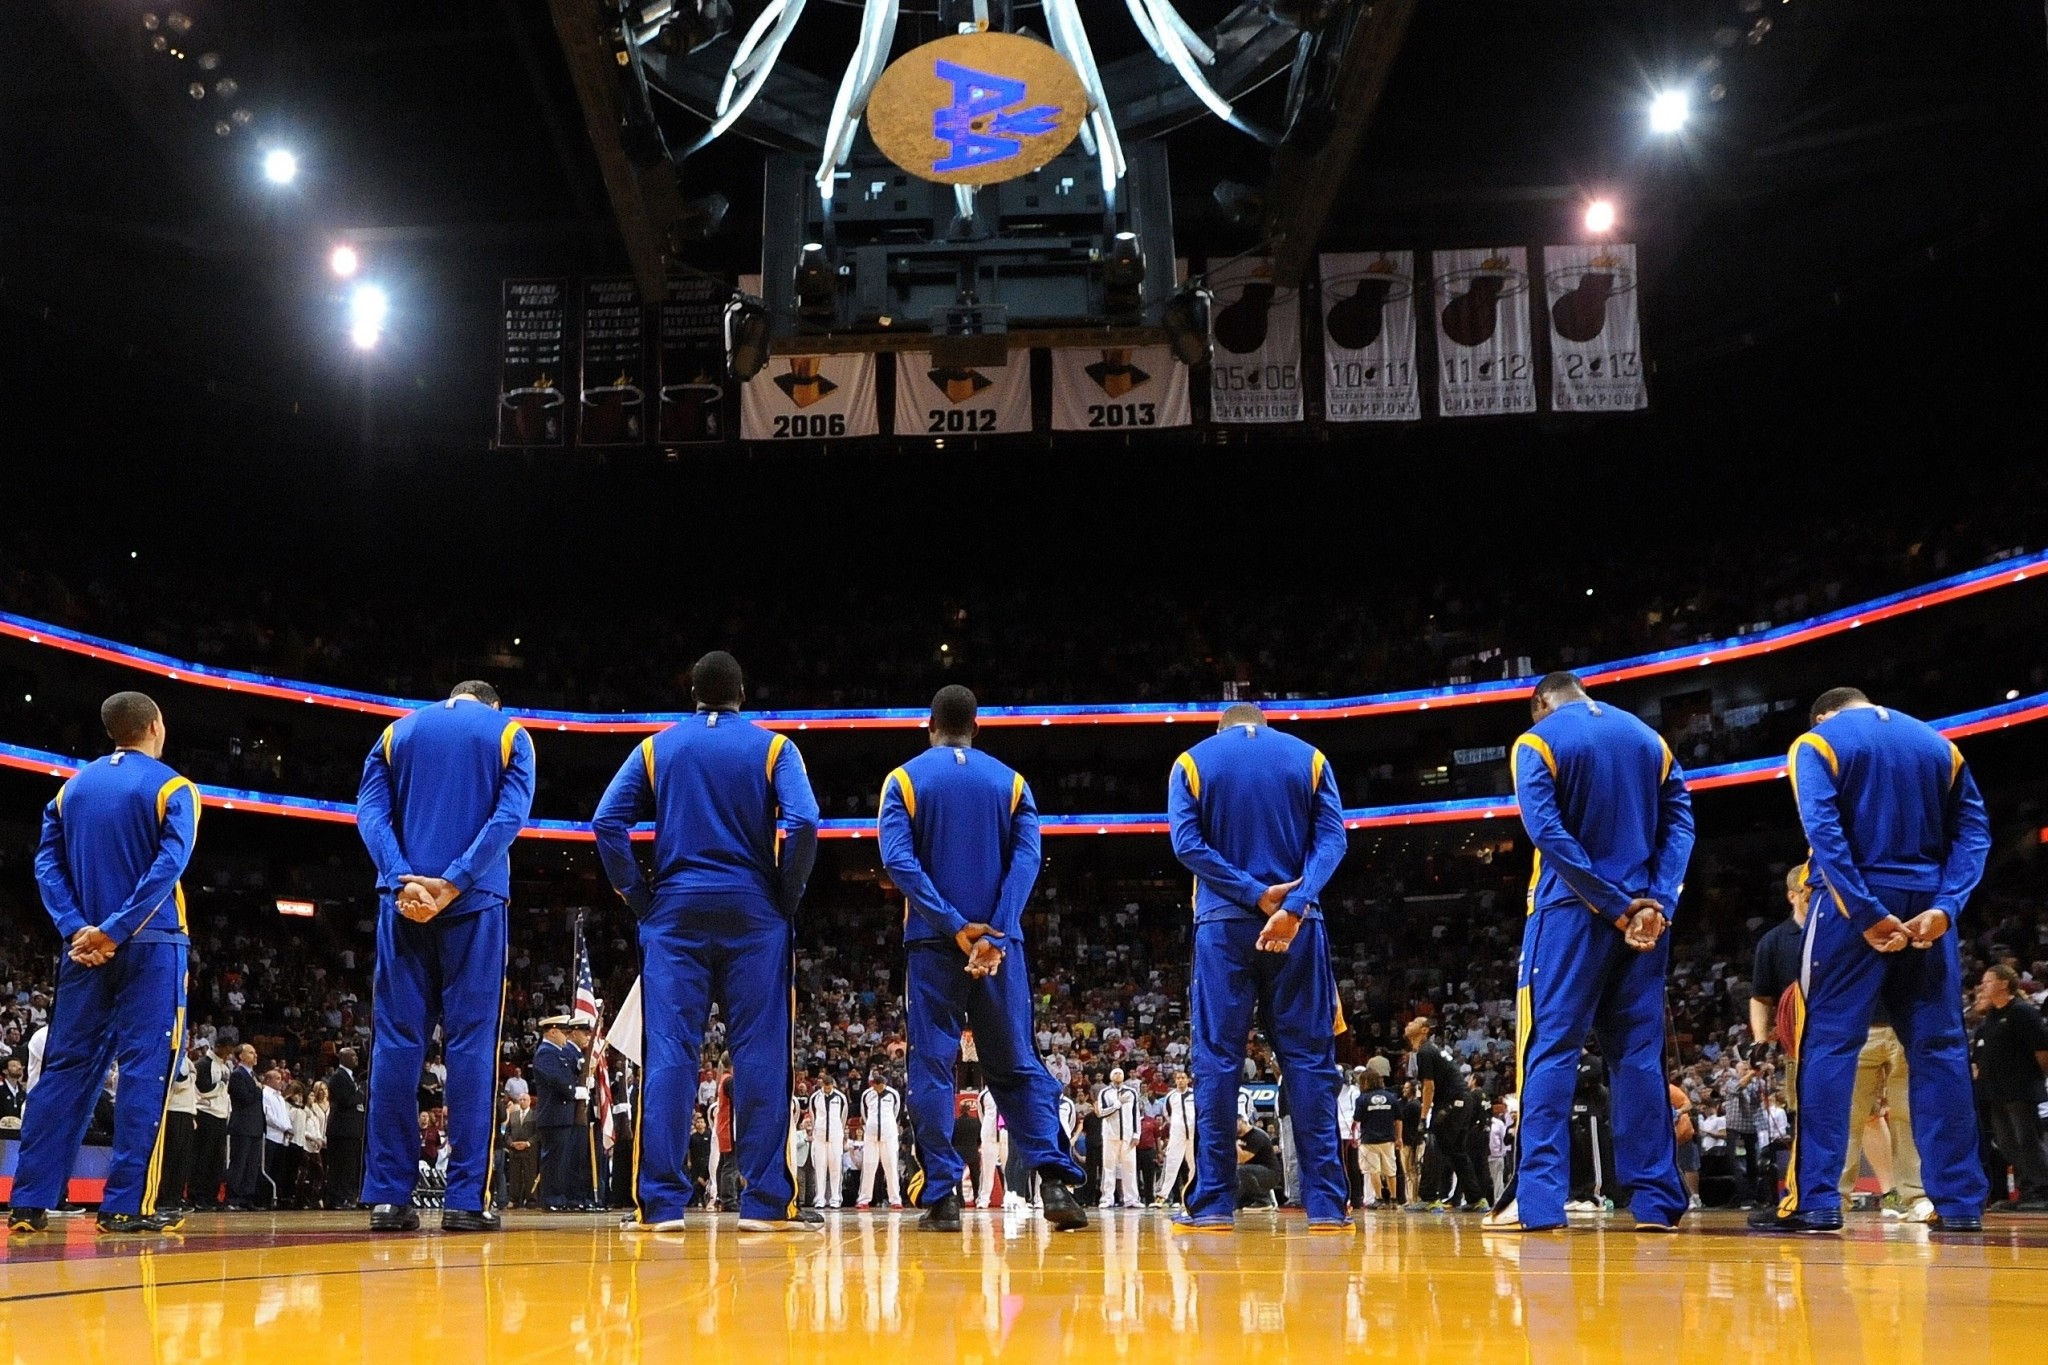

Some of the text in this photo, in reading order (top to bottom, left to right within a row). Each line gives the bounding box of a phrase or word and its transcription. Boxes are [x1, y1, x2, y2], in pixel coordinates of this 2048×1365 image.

[1333, 361, 1411, 388] 10 11
[1445, 354, 1527, 384] 11 12
[1609, 352, 1637, 378] 13
[1214, 365, 1296, 391] 05 06
[928, 408, 997, 433] 2012
[1088, 402, 1155, 428] 2013
[1216, 404, 1299, 418] CHAMPIONS
[1330, 402, 1415, 415] CHAMPIONS
[773, 413, 845, 438] 2006
[1248, 1089, 1275, 1101] UD
